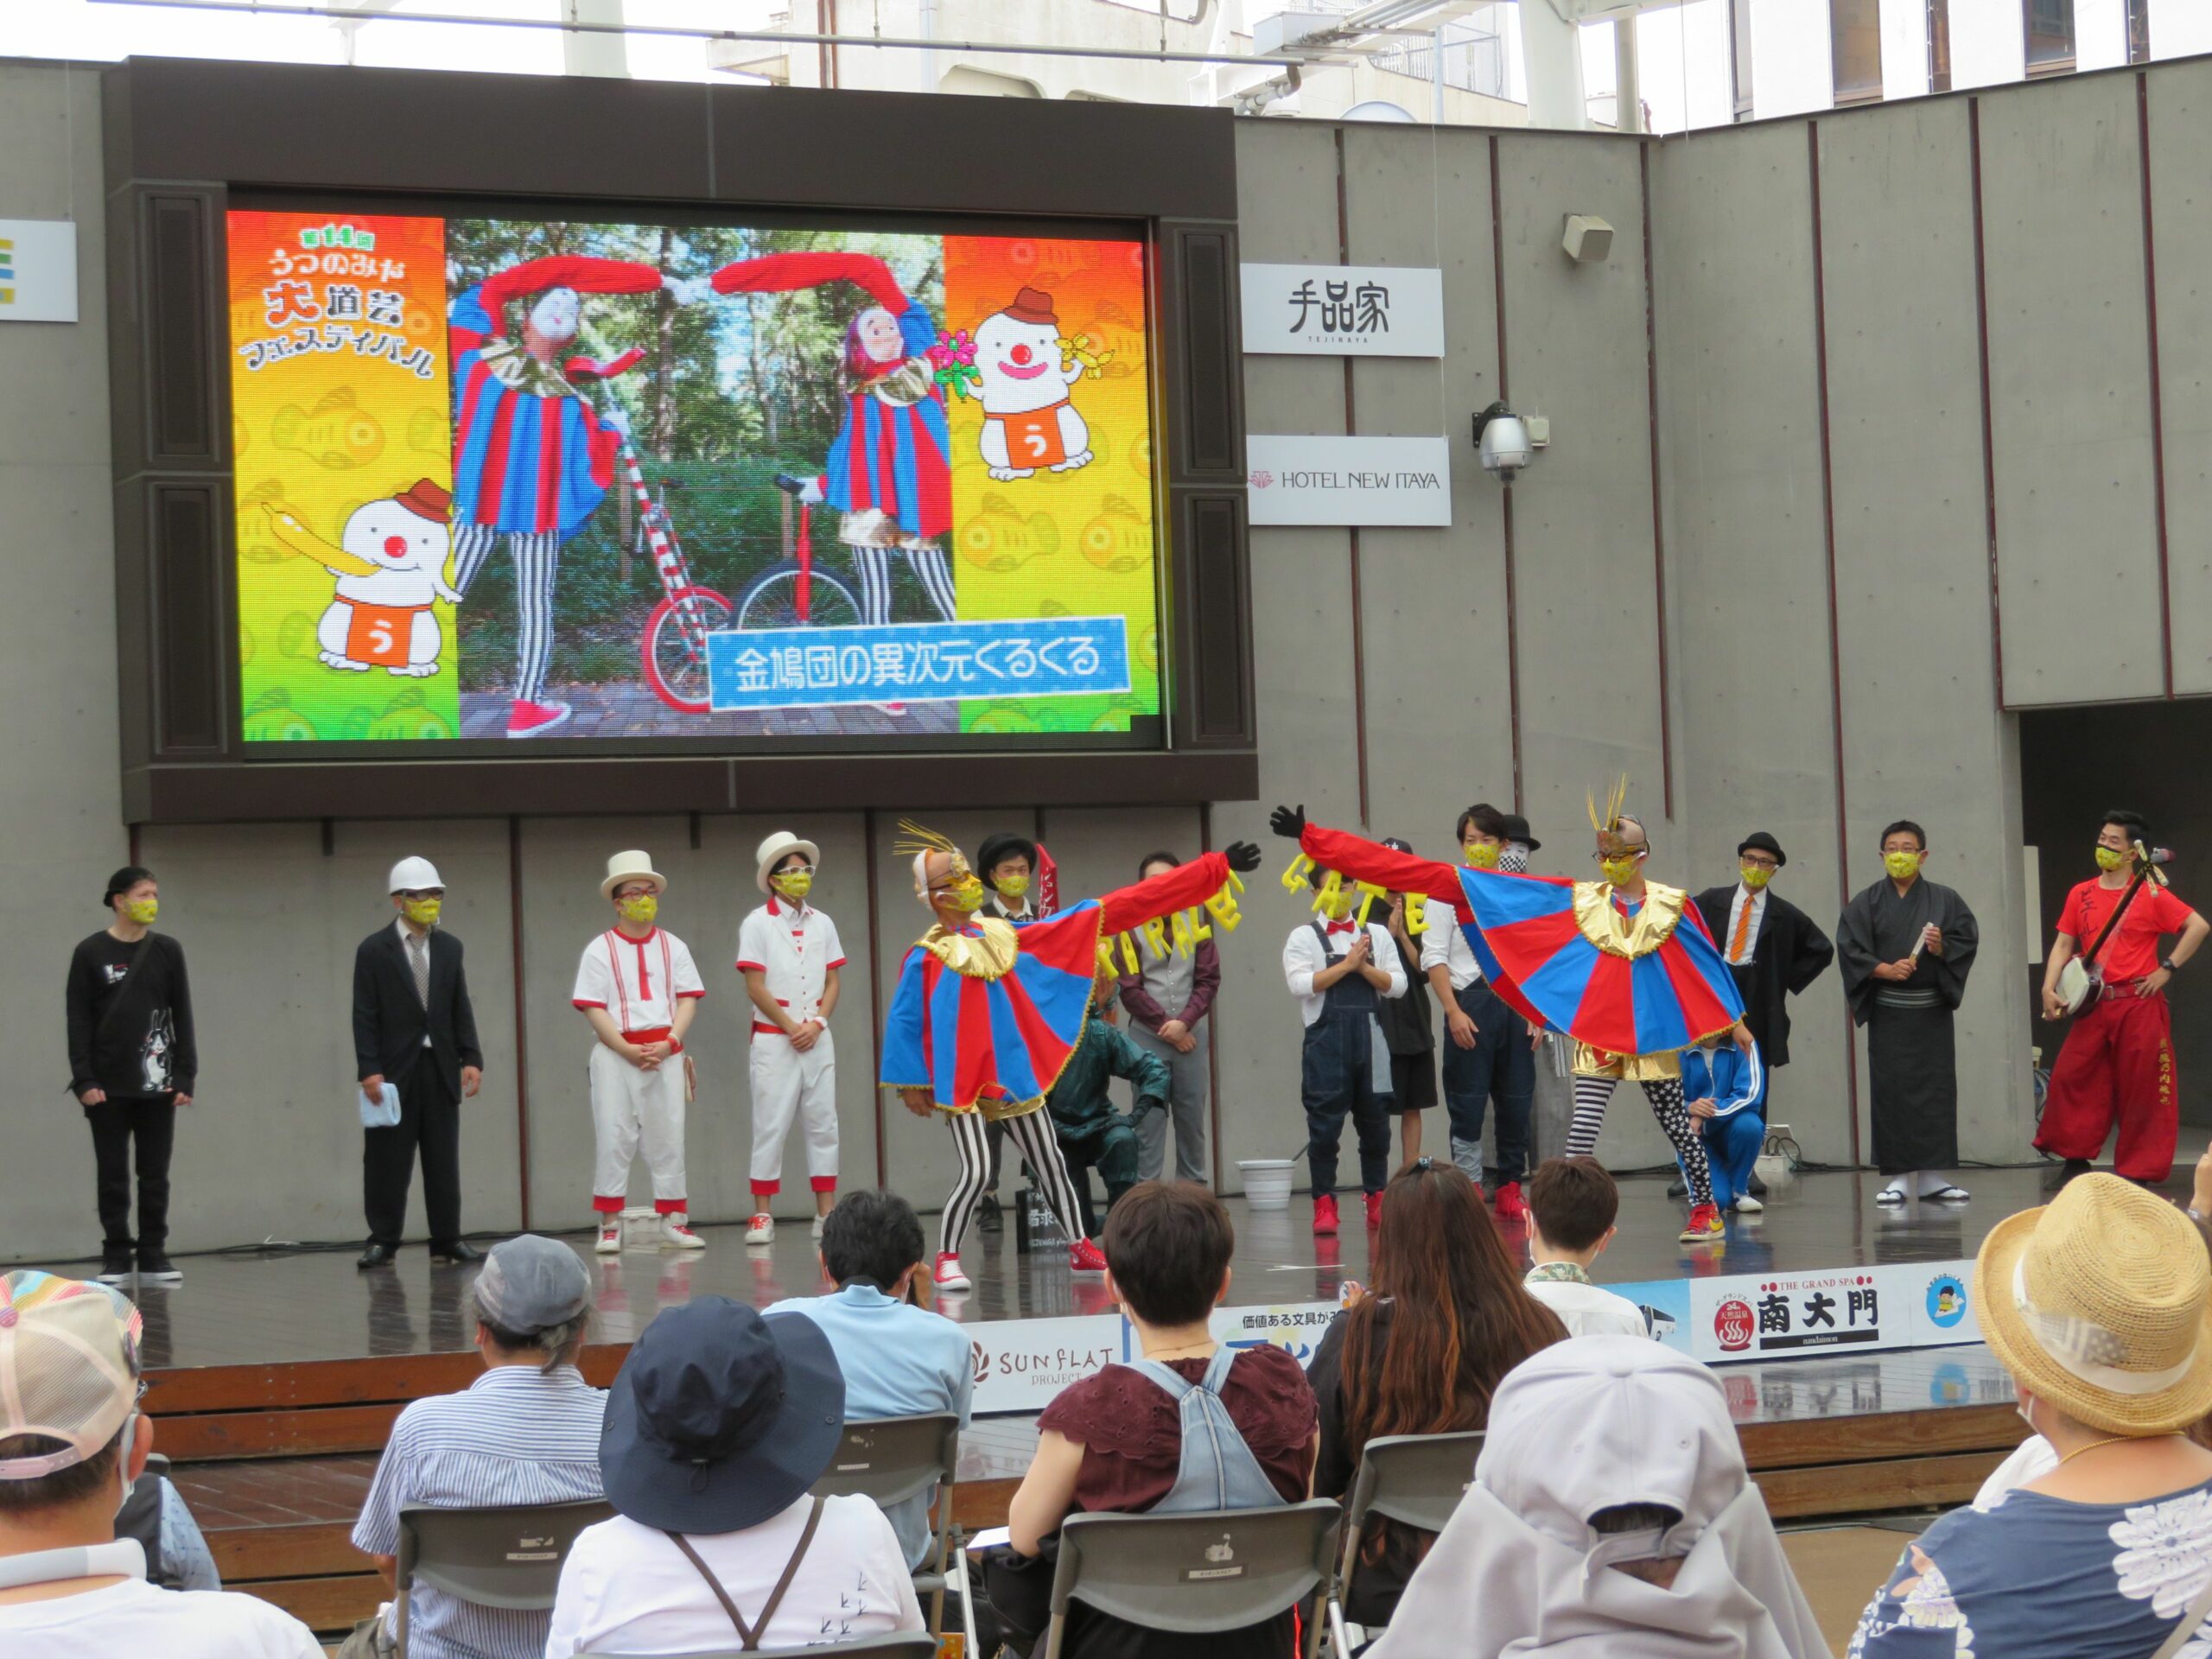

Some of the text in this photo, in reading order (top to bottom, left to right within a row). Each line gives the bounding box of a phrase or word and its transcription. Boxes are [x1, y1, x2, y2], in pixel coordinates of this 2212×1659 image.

[263, 279, 404, 328] 大道芸
[1288, 279, 1389, 334] 手品家
[239, 324, 435, 378] フェスティバル
[1282, 472, 1440, 489] HOTEL NEW ITAYA
[734, 635, 1099, 693] 金鳩団の異次元くるくる
[1780, 1277, 1855, 1291] THE GRAND SPA
[1757, 1288, 1878, 1334] 南大門
[1802, 1336, 1838, 1345] nandaimon
[1032, 1372, 1082, 1386] PROJECT
